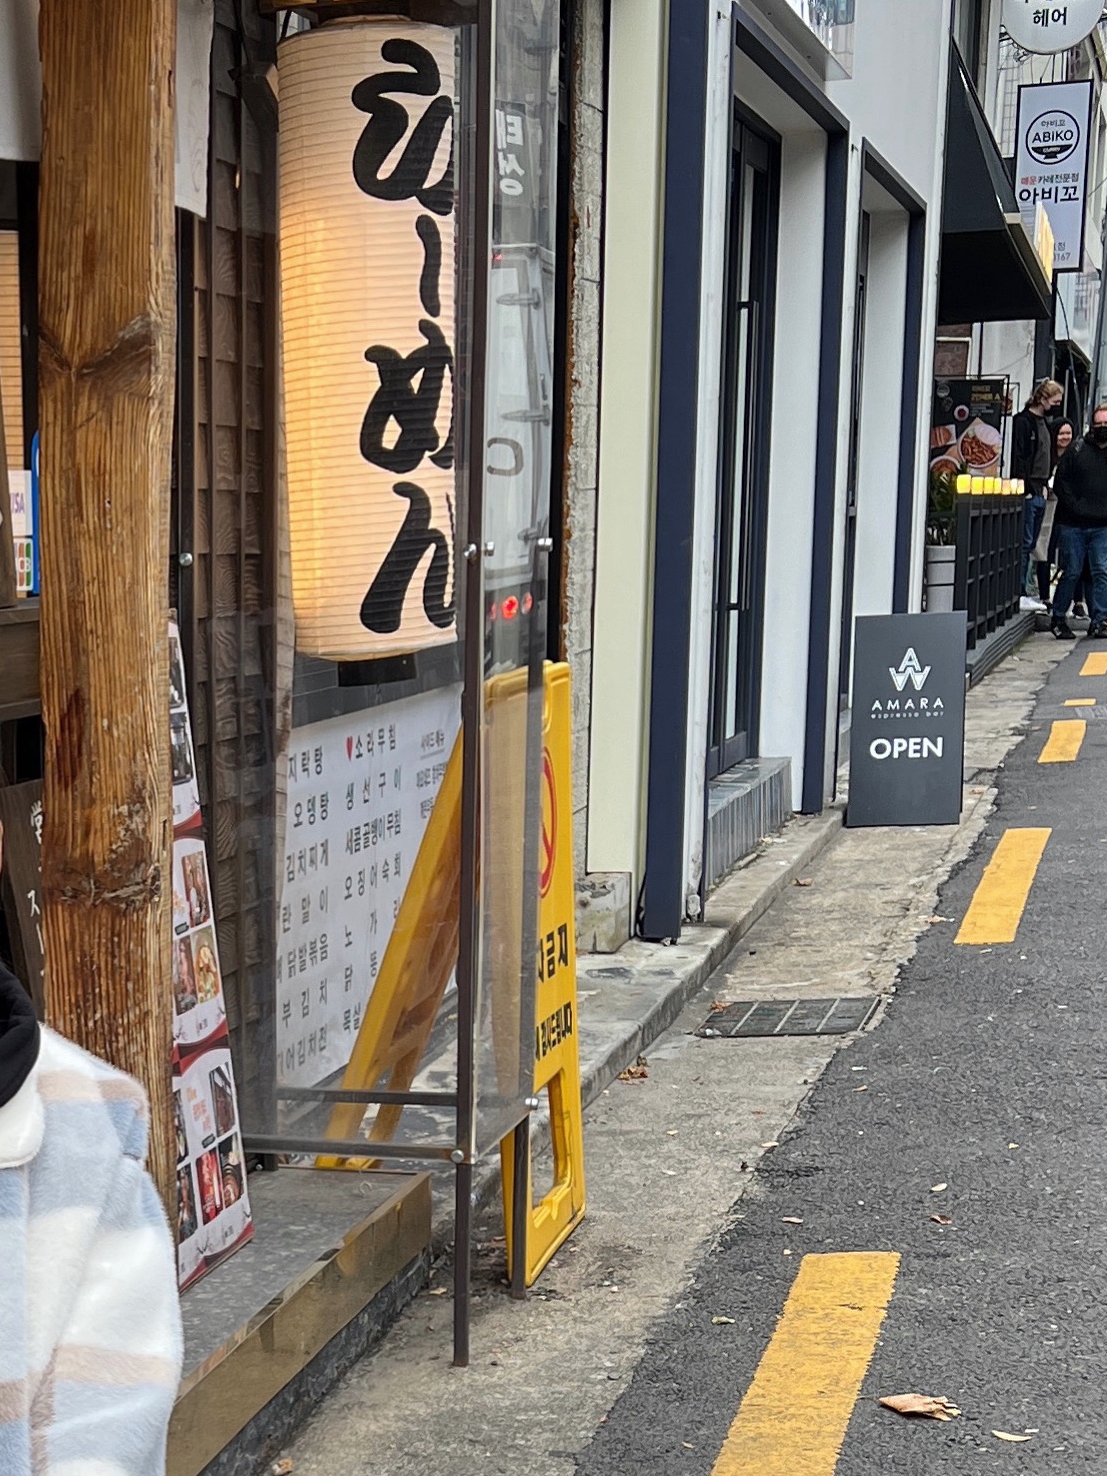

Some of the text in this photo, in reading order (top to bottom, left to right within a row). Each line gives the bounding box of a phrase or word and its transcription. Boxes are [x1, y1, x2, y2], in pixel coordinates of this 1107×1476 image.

[1033, 7, 1068, 27] 헤어
[1032, 129, 1074, 143] ABIKO
[1019, 186, 1080, 206] 아비꼬
[871, 697, 944, 711] AMARA
[869, 736, 944, 760] OPEN
[288, 745, 322, 787] 지락탕
